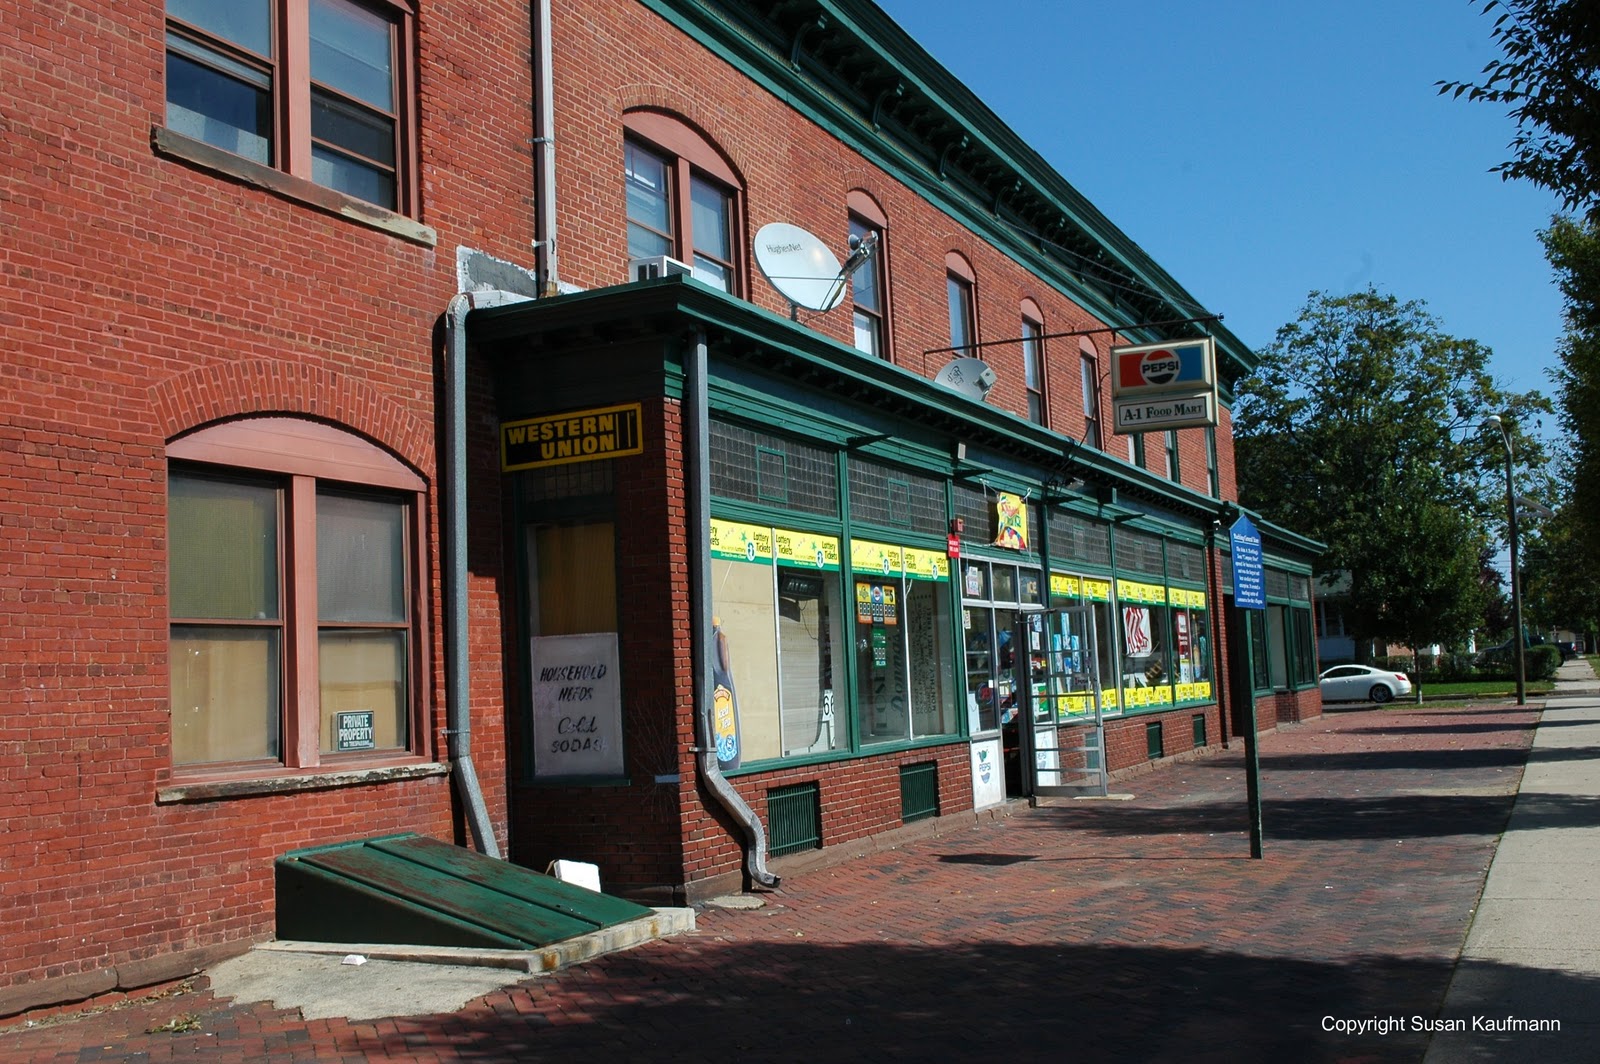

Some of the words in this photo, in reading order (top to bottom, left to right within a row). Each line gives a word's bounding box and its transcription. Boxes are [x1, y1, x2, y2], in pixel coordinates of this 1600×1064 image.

[766, 243, 803, 255] HughesNet
[1141, 360, 1179, 374] PEPSI
[1123, 408, 1142, 421] A-1
[507, 414, 614, 445] WESTERN
[540, 434, 615, 460] UNION
[753, 531, 770, 542] Lottery
[775, 534, 791, 546] Lottery
[756, 542, 771, 554] Tickets
[777, 545, 792, 556] Tickets
[821, 540, 836, 551] Lottery
[824, 550, 838, 561] Tickets
[540, 664, 607, 682] HOUSEHOLD
[558, 687, 594, 702] NEEDS
[343, 714, 369, 729] PRIVATE
[339, 727, 373, 742] PROPERTY
